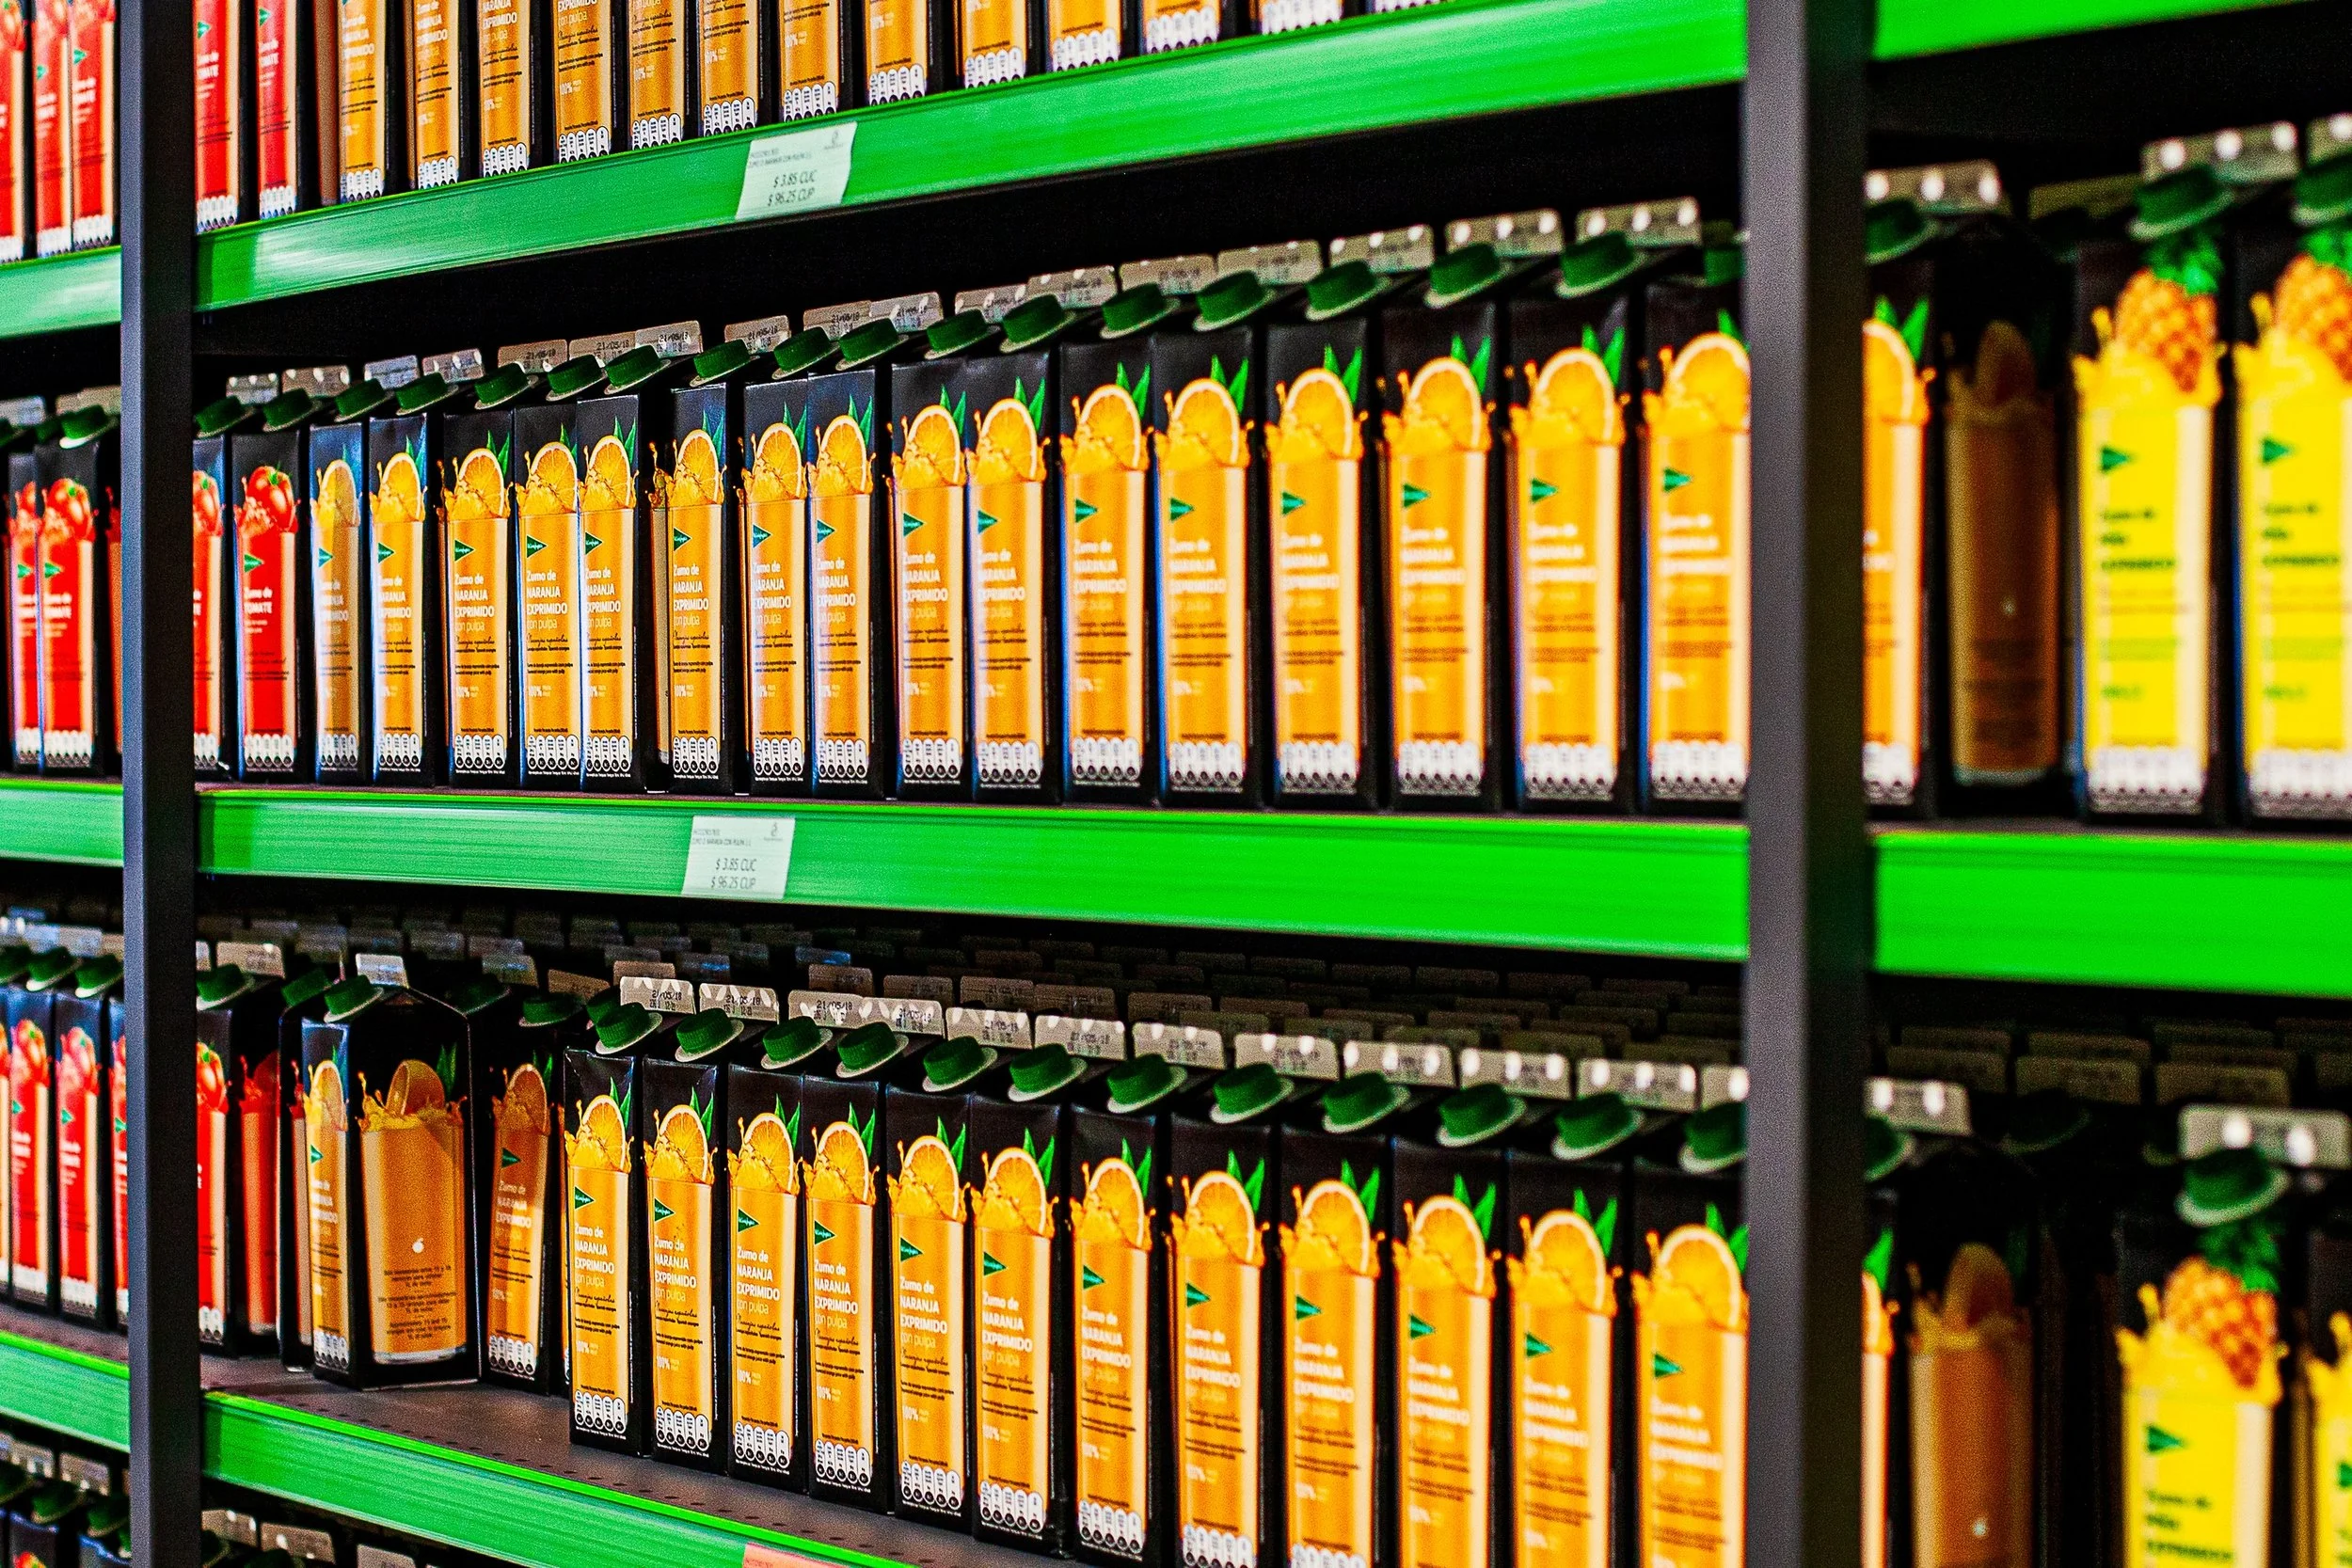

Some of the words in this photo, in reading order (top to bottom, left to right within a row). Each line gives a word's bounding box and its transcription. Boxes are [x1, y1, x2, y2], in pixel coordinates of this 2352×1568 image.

[527, 569, 545, 581] Zumo
[548, 570, 556, 580] de
[674, 564, 689, 576] Zumo
[691, 563, 700, 575] de
[527, 586, 561, 598] NARANJA
[674, 581, 703, 593] NARANJA
[527, 602, 568, 615] EXPRIMIDO
[674, 598, 708, 611] EXPRIMIDO
[740, 858, 756, 871] CUC
[575, 1223, 593, 1236] Zumo
[595, 1227, 604, 1238] de
[575, 1241, 608, 1257] NARANJA
[655, 1236, 673, 1250] Zumo
[675, 1240, 685, 1252] de
[655, 1254, 689, 1270] NARANJA
[738, 1246, 756, 1261] Zumo
[758, 1250, 769, 1262] de
[575, 1257, 614, 1274] EXPRIMIDO
[738, 1265, 773, 1282] NARANJA
[815, 1259, 834, 1274] Zumo
[835, 1262, 846, 1275] de
[655, 1271, 696, 1289] EXPRIMIDO
[815, 1278, 850, 1295] NARANJA
[899, 1275, 922, 1291] Zumo
[924, 1281, 935, 1294] de
[738, 1283, 780, 1301] EXPRIMIDO
[815, 1296, 858, 1315] EXPRIMIDO
[899, 1295, 939, 1313] NARANJA
[982, 1291, 1006, 1307] Zumo
[1007, 1297, 1019, 1311] de
[900, 1315, 948, 1334] EXPRIMIDO
[982, 1311, 1024, 1331] NARANJA
[982, 1330, 1033, 1353] EXPRIMIDO
